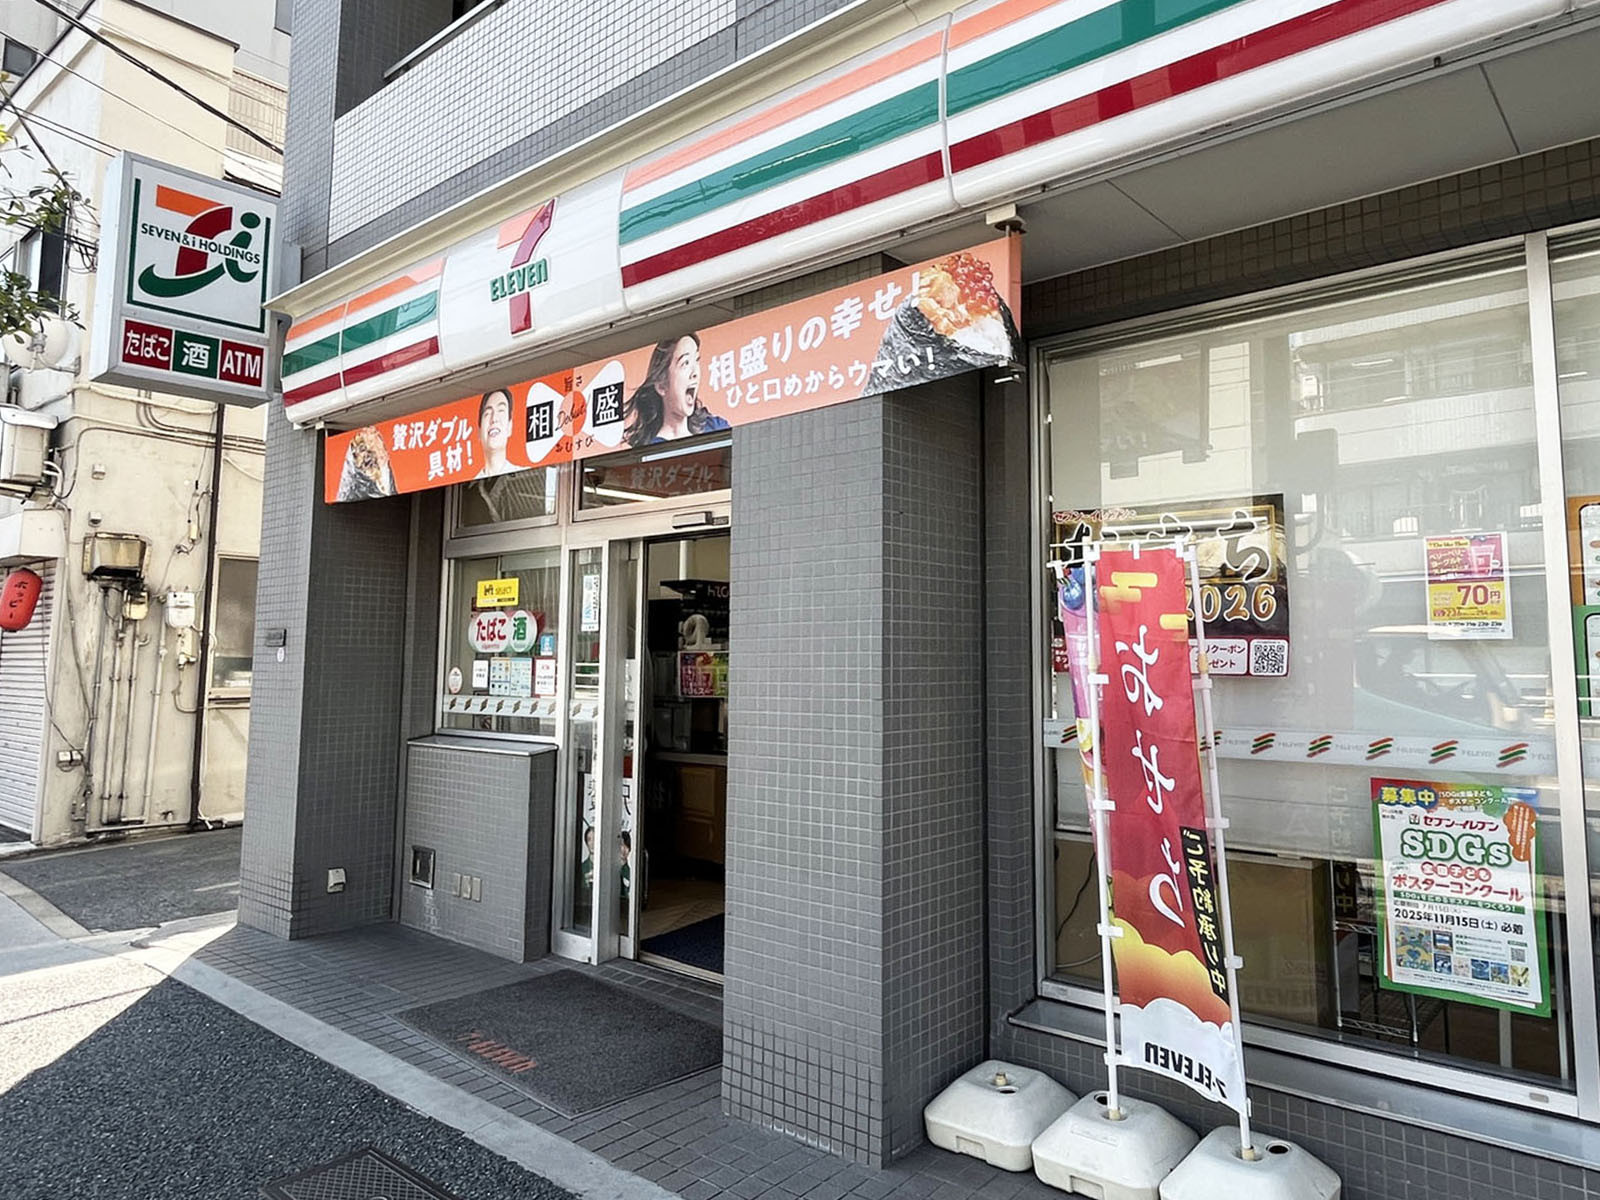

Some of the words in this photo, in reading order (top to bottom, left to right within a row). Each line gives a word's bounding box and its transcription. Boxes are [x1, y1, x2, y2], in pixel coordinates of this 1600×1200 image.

[199, 239, 260, 265] HOLDINGS
[125, 329, 170, 361] たばこ
[182, 340, 211, 369] 酒
[222, 349, 261, 379] ATM
[725, 346, 936, 409] ひと口めからウマい！
[528, 405, 551, 439] 相
[595, 385, 620, 425] 盛
[392, 416, 473, 451] 贅沢ダブル
[428, 441, 473, 481] 具材！
[475, 618, 507, 642] たばこ
[512, 617, 527, 641] 酒
[1381, 786, 1435, 806] 募集中
[1401, 828, 1512, 867] SDGs
[1393, 874, 1524, 902] ポスターコンクール
[1501, 922, 1524, 935] 必着
